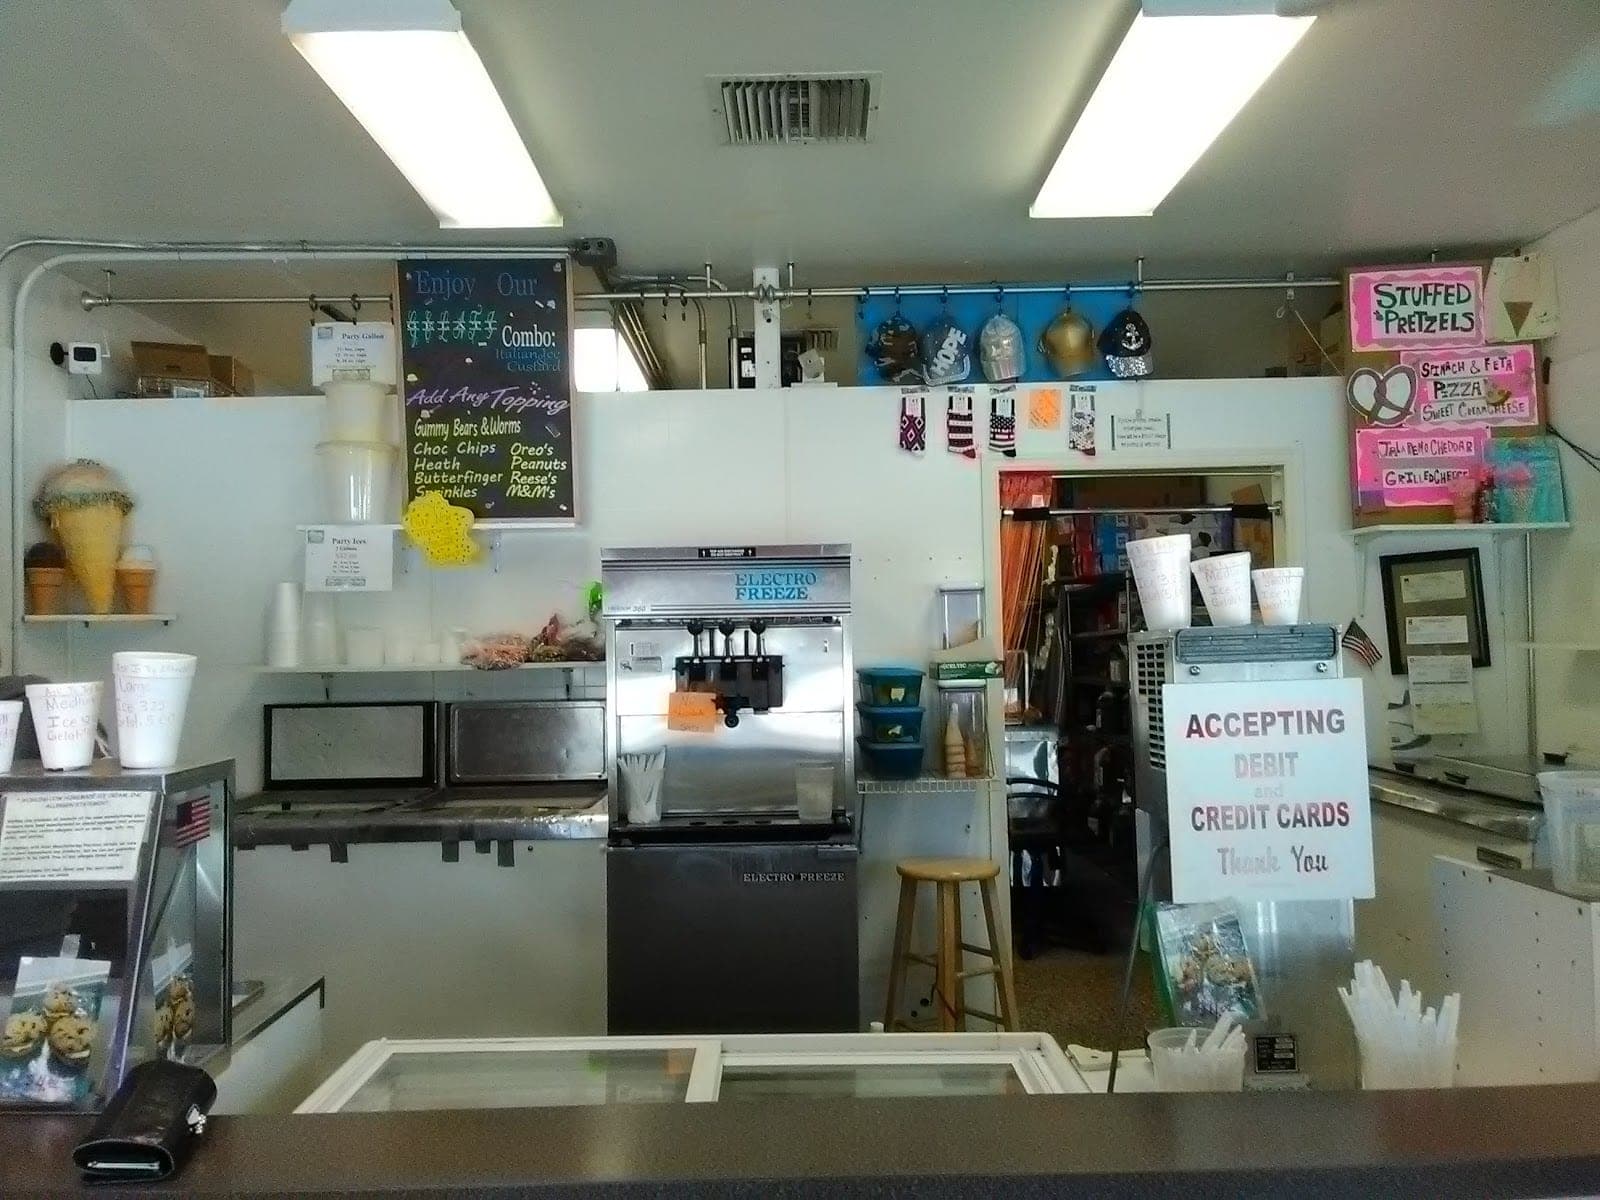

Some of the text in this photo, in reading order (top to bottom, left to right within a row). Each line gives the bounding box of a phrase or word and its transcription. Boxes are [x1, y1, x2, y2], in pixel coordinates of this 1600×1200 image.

[416, 270, 538, 300] Enjoy Our
[1373, 282, 1472, 309] STUFFED
[1384, 310, 1475, 334] PRETZELS
[502, 325, 556, 347] Combo:
[1421, 356, 1513, 378] SPINACH & FETA
[1433, 380, 1483, 400] PIZZA
[406, 386, 570, 415] Add Any Topping
[1422, 403, 1455, 421] SWEET
[414, 418, 450, 444] Gummy
[453, 418, 478, 437] Bears
[413, 441, 497, 457] Choc Chips
[510, 442, 554, 456] Oreo's
[414, 457, 460, 471] Heath
[510, 456, 567, 471] Peanuts
[414, 470, 503, 485] Butterfinger
[510, 470, 557, 485] Reese's
[506, 484, 556, 499] M&M's
[735, 572, 817, 587] ELECTRO
[735, 586, 809, 601] FREEZE
[1185, 708, 1346, 739] ACCEPTING
[1234, 751, 1299, 779] DEBIT
[1254, 783, 1284, 798] and
[1191, 801, 1350, 832] CREDIT CARDS
[1217, 845, 1329, 875] Thank You
[743, 872, 846, 882] ELECTRO FREEZE
